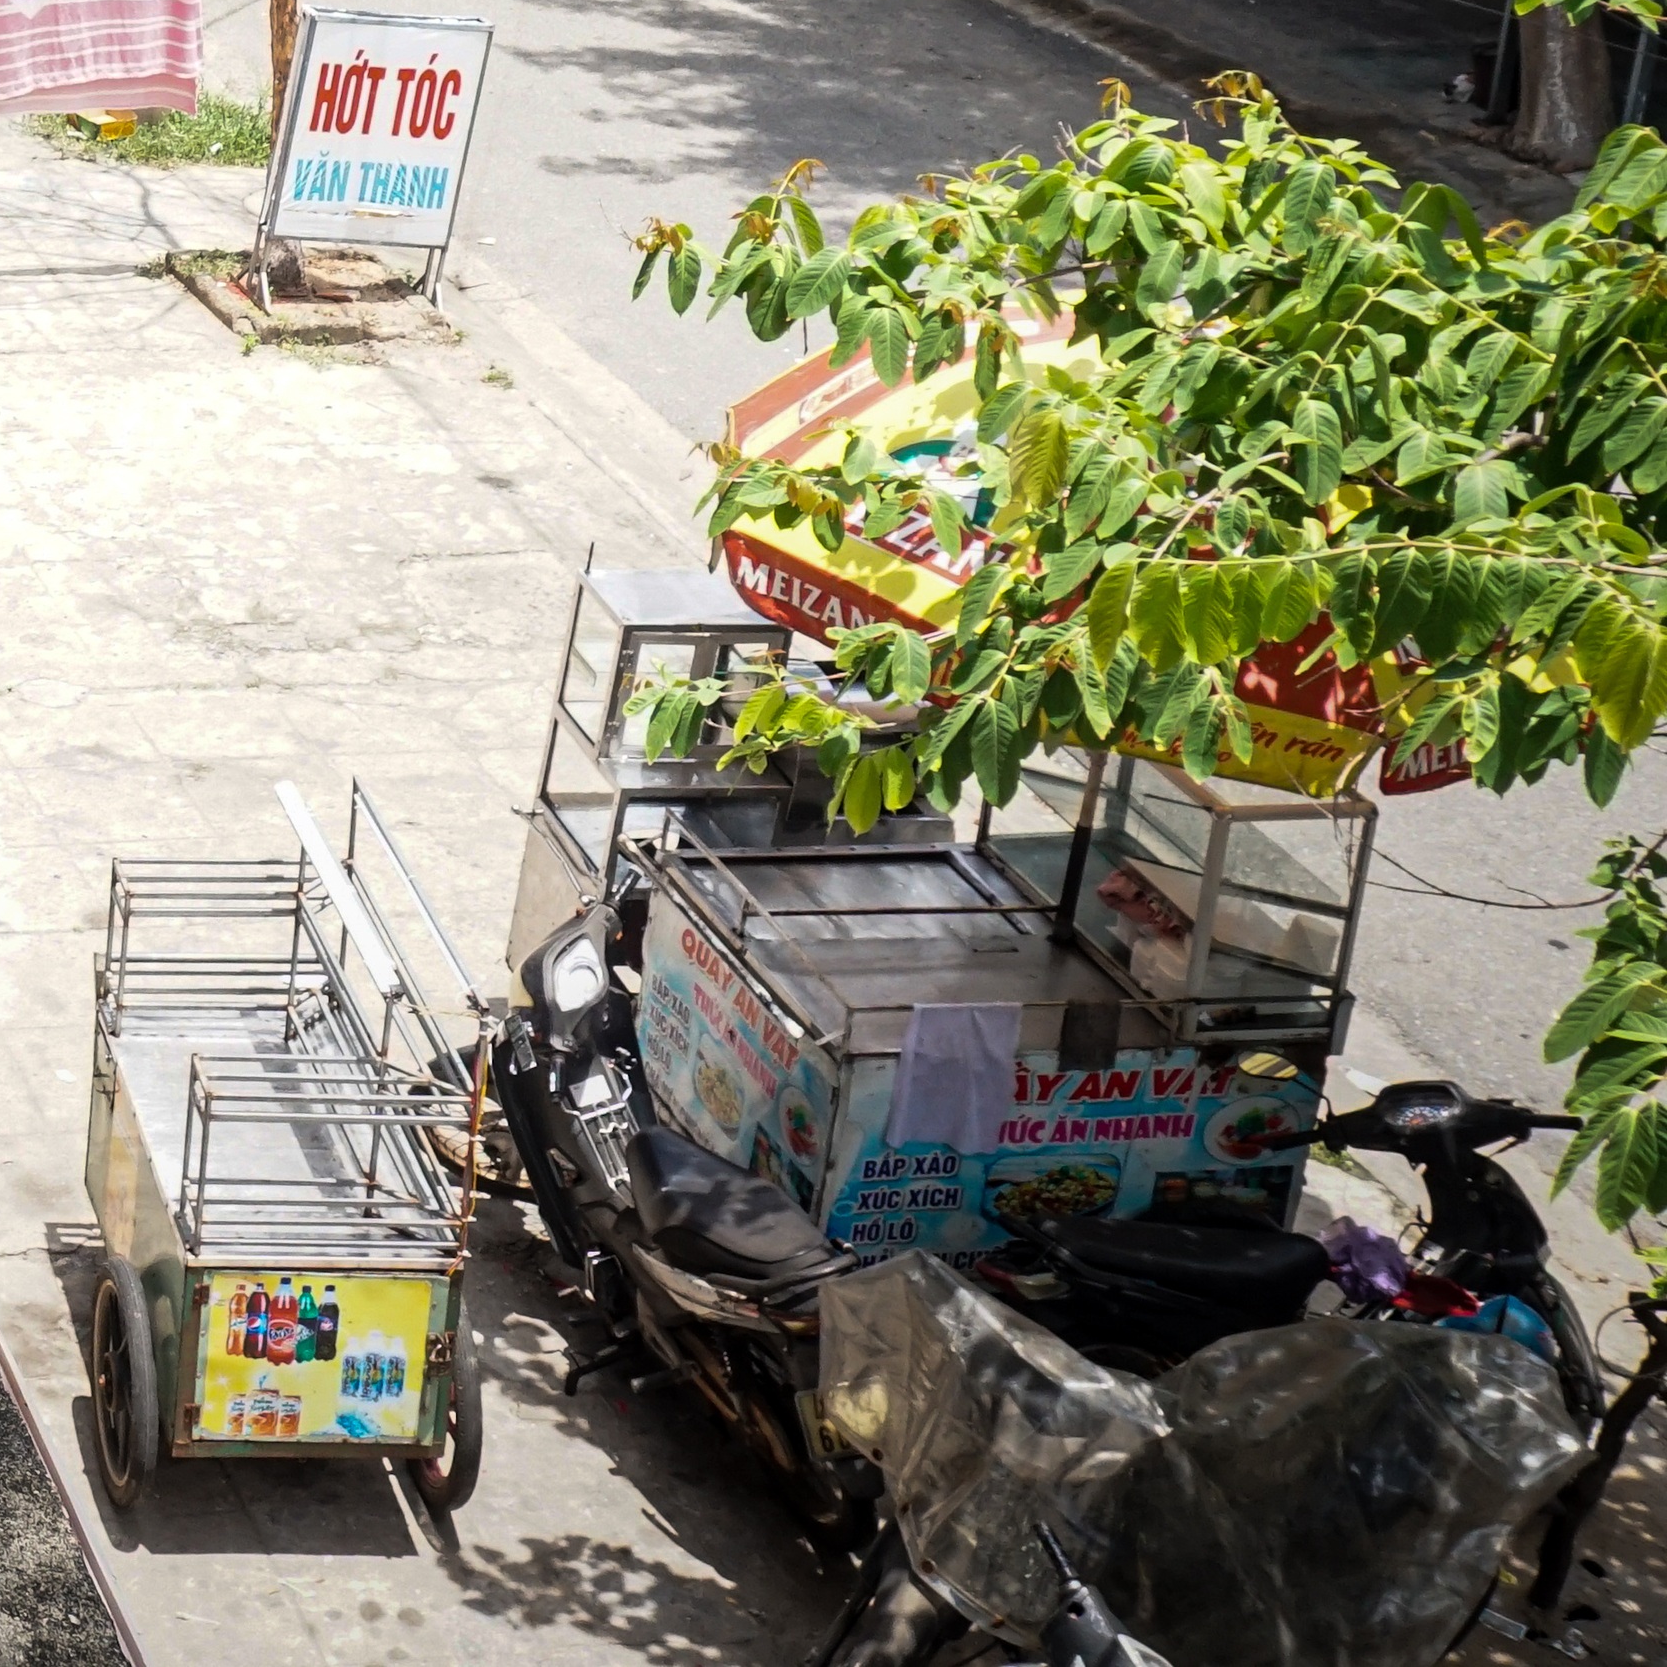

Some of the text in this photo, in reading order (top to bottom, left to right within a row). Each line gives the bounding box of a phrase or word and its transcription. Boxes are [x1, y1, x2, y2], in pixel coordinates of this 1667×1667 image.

[309, 50, 462, 140] HỚT TÓC
[292, 150, 449, 210] VĂN THANH
[1049, 1114, 1090, 1143] ĂN
[1093, 1113, 1196, 1142] NHANH
[857, 1183, 959, 1210] XÚC XÍCH
